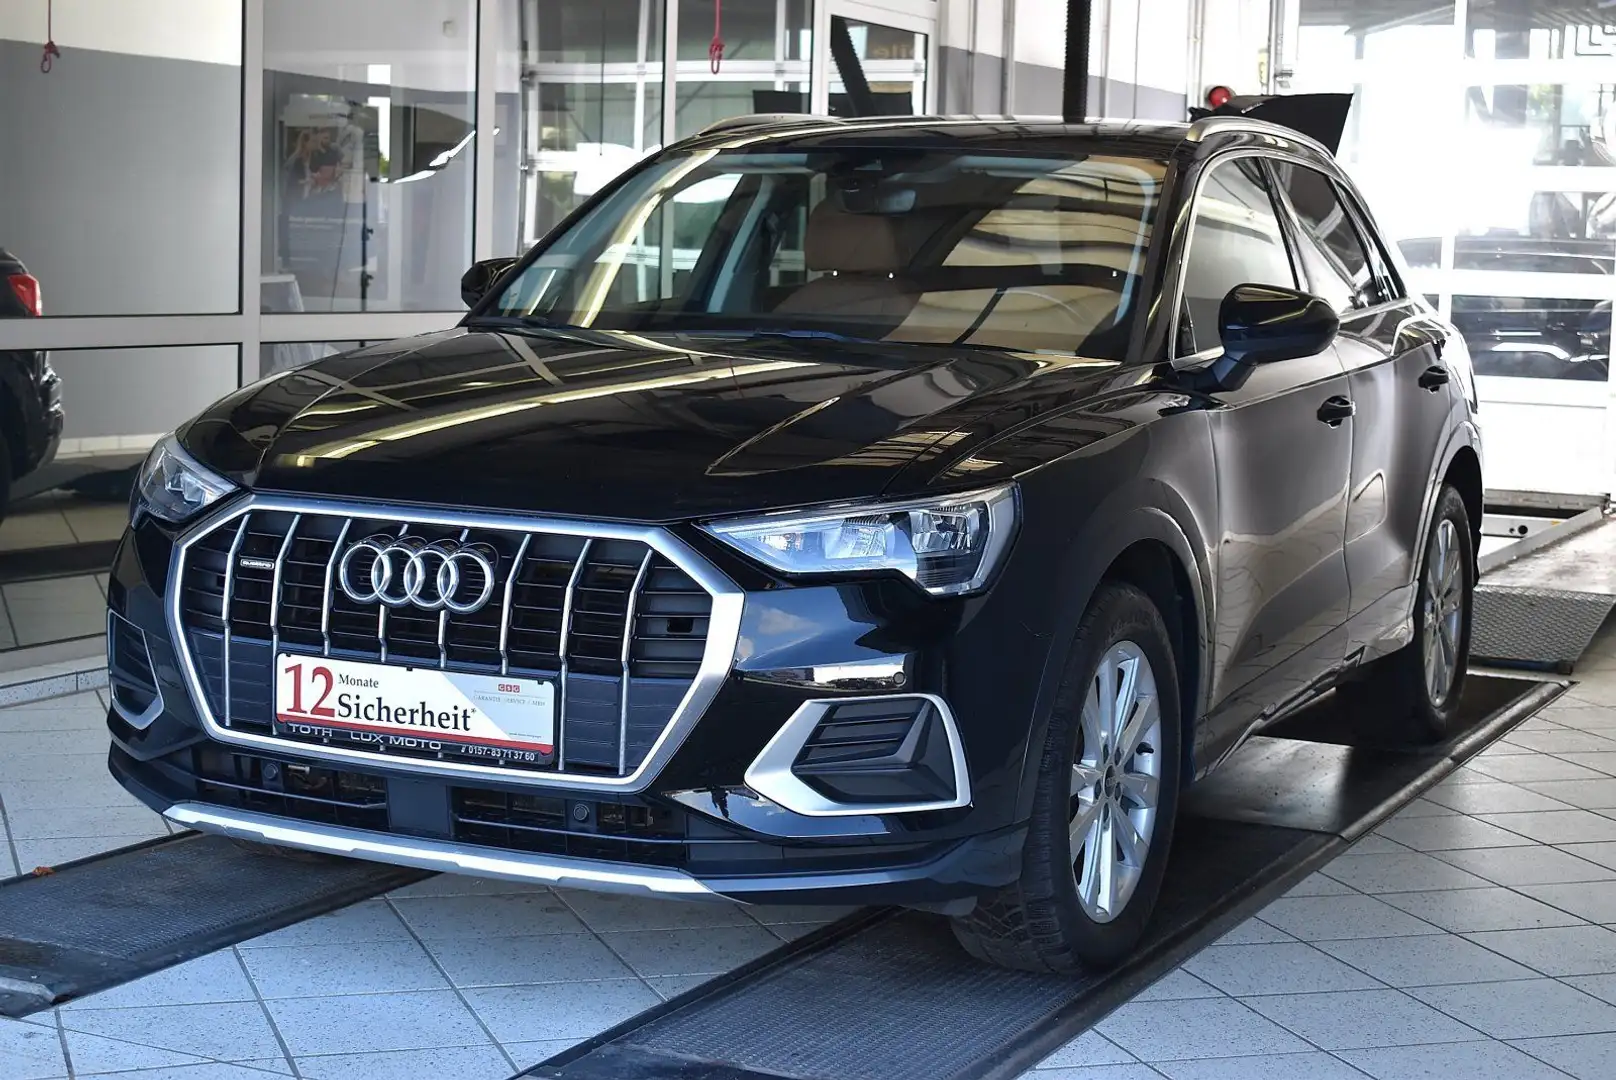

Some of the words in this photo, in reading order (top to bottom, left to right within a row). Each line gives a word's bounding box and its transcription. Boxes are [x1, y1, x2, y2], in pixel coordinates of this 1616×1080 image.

[284, 663, 335, 717] 12
[338, 674, 379, 689] Monate
[288, 722, 332, 737] TOTH
[350, 731, 384, 743] LUX
[389, 735, 442, 750] MOTO
[502, 749, 512, 758] 71
[514, 751, 523, 760] 37
[525, 752, 535, 761] 60
